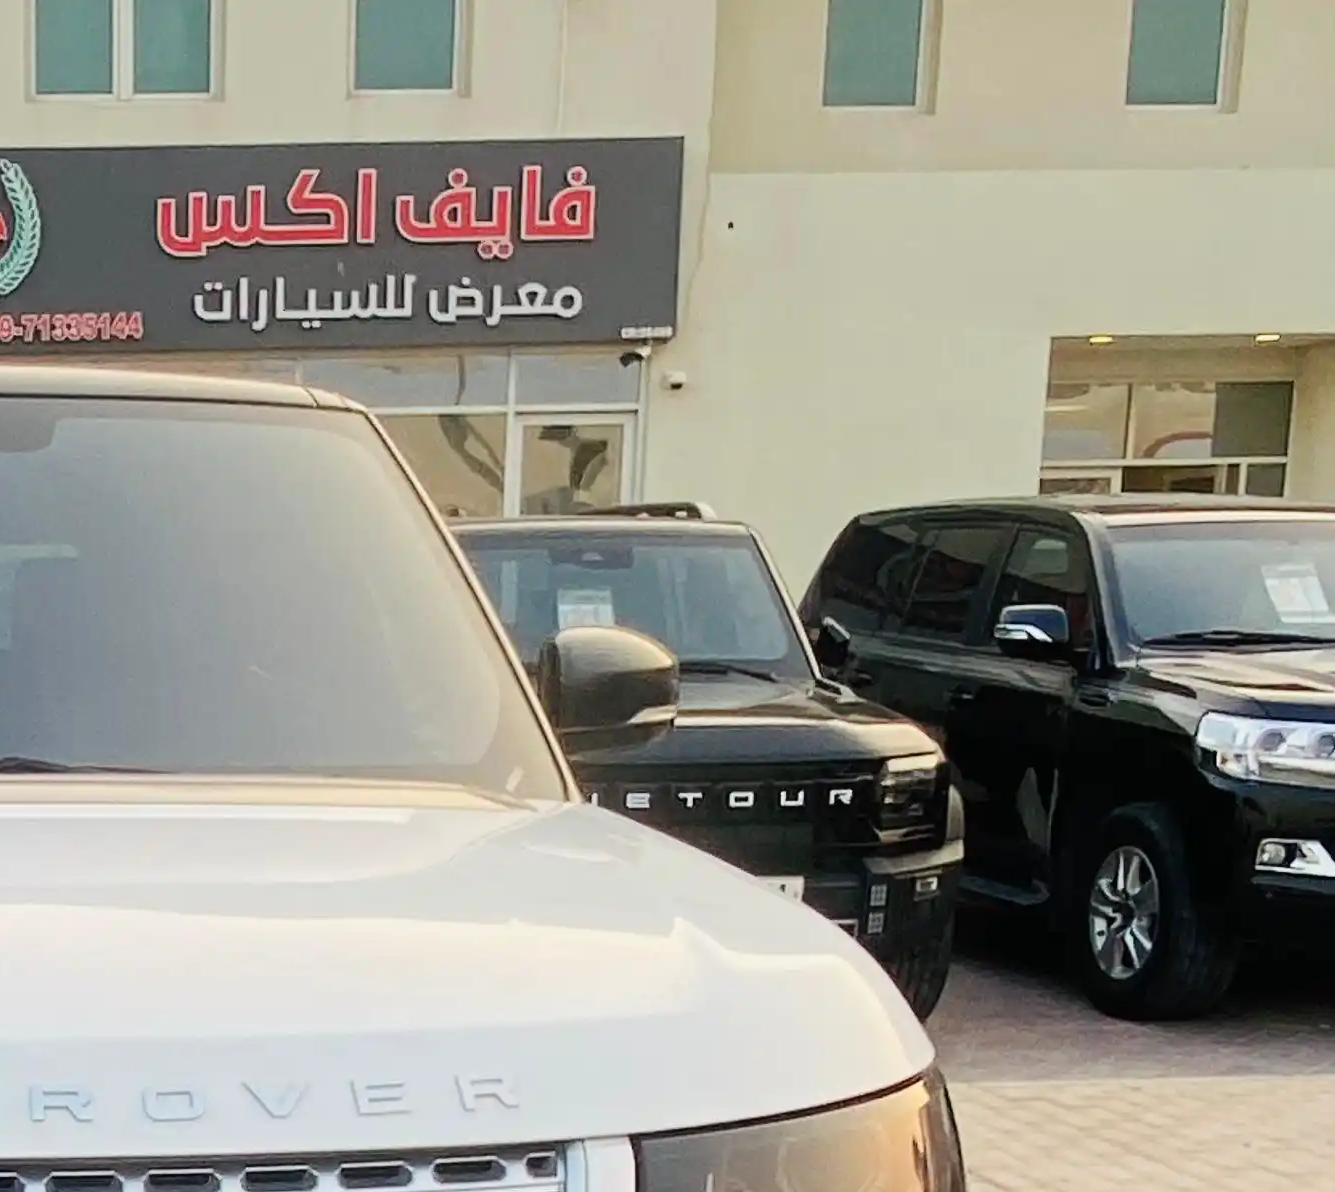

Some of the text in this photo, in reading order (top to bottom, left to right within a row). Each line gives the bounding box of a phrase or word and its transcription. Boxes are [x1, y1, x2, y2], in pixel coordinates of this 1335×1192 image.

[155, 165, 597, 260] فايف اكس
[192, 272, 584, 332] معرض للسيارات
[27, 1073, 521, 1123] ROVER
